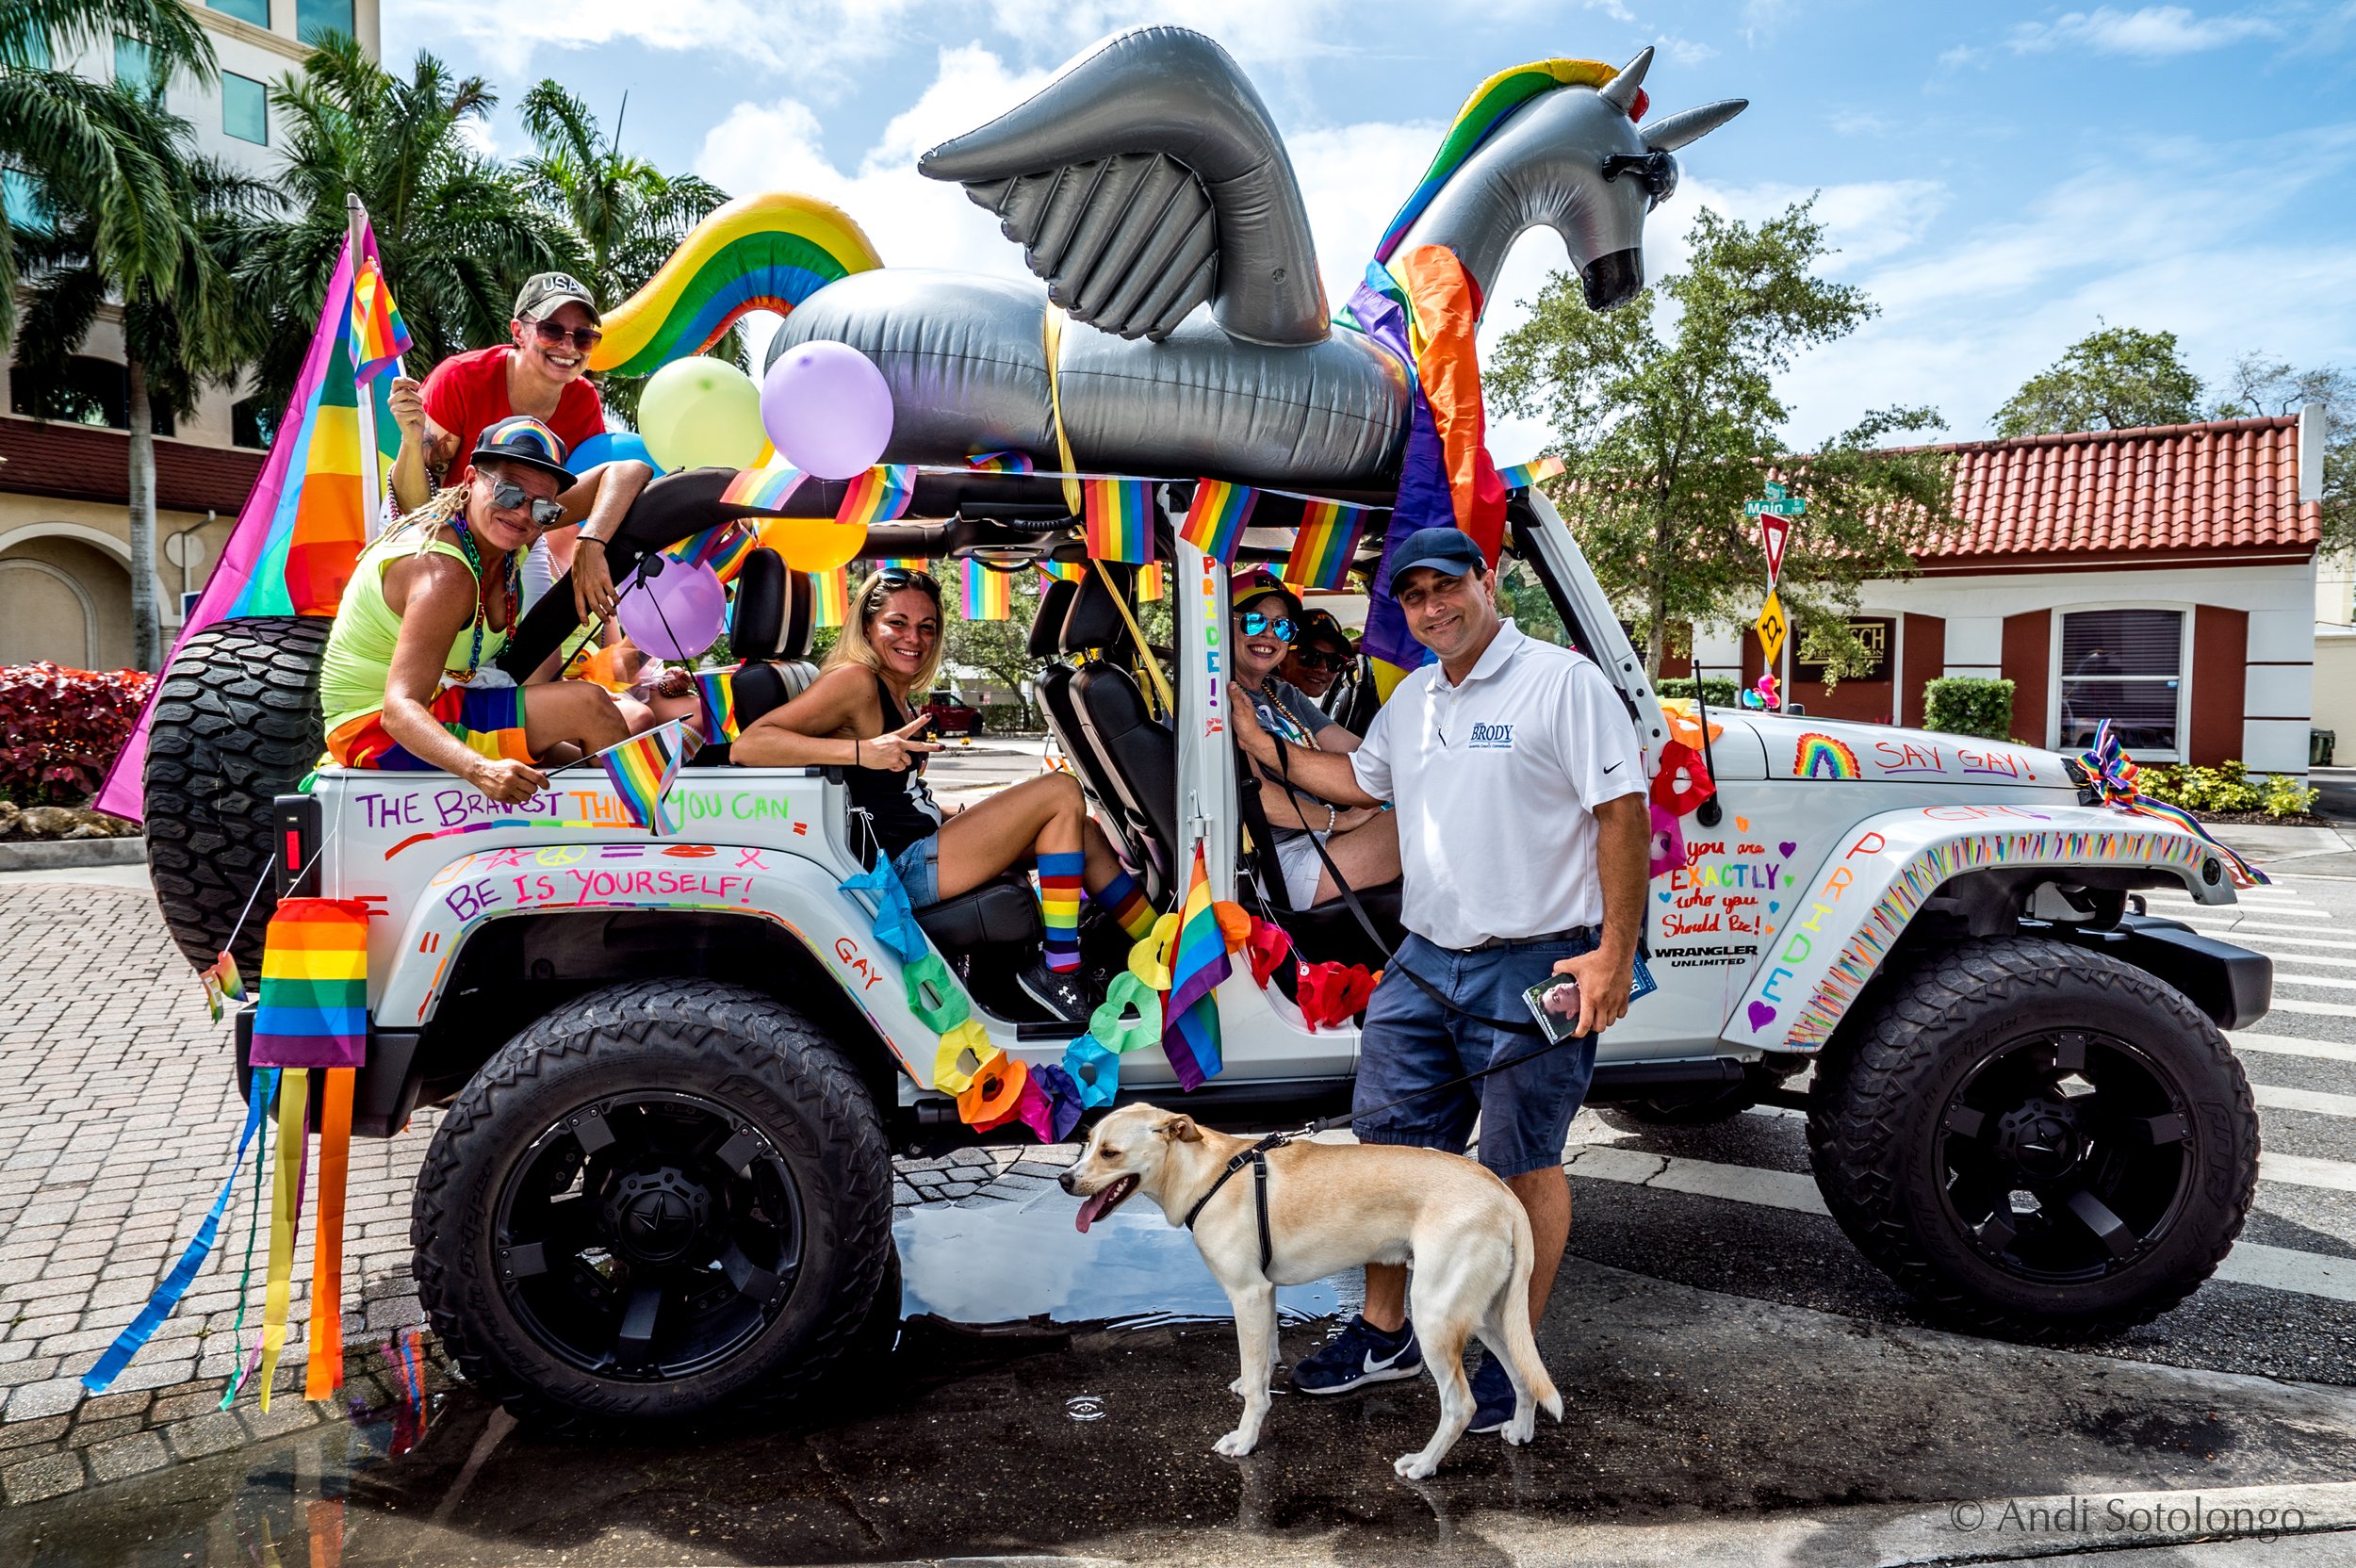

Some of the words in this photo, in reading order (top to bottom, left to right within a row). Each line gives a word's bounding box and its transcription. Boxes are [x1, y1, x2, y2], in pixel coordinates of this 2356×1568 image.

[543, 276, 582, 292] USA
[1748, 501, 1783, 514] Main
[1203, 556, 1220, 707] PRIDE!
[1470, 725, 1513, 740] BRODY
[1874, 742, 1941, 770] SAY
[1957, 749, 2037, 781] GAY!
[355, 792, 424, 827] THE
[667, 789, 722, 831] YOU
[732, 792, 790, 821] CAN
[1687, 841, 1726, 866] you
[1737, 842, 1765, 855] are
[1671, 862, 1779, 891] EXACTLY
[445, 878, 502, 922] BE
[513, 874, 556, 905] IS
[565, 868, 755, 907] YOURSELF!
[1674, 888, 1716, 909] who
[1723, 895, 1759, 914] you
[1661, 913, 1722, 938] Should
[1727, 914, 1760, 936] Be!
[1761, 831, 1886, 1004] PRIDE
[835, 938, 883, 990] GAY
[1655, 945, 1759, 958] WRANGLER
[1671, 957, 1746, 968] UNLIMITED
